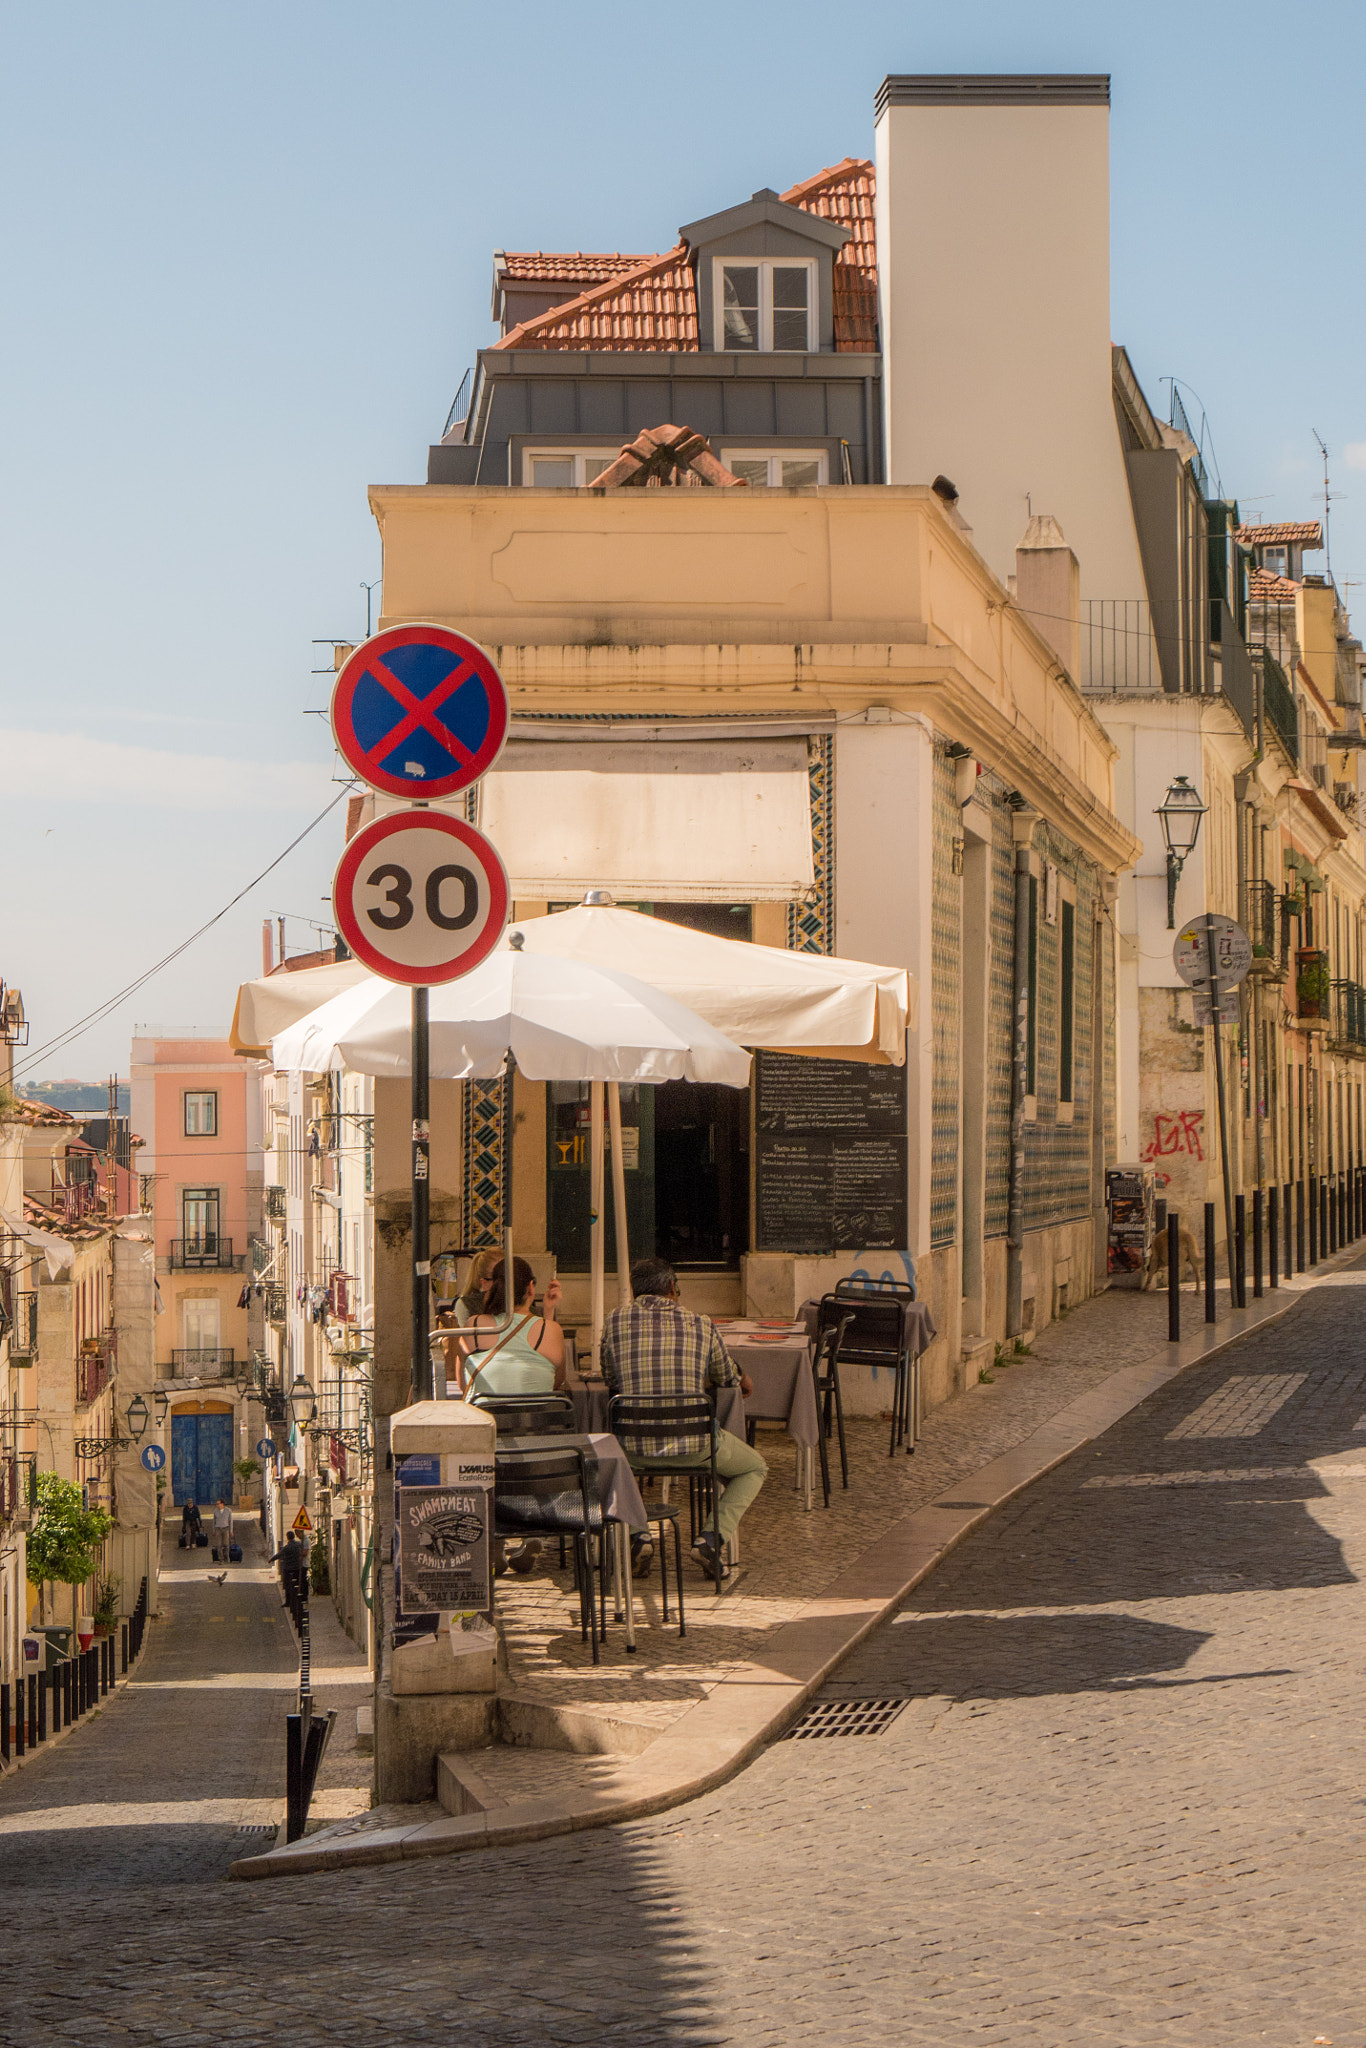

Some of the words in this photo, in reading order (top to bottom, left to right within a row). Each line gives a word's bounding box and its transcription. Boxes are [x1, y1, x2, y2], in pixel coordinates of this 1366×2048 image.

[366, 863, 478, 931] 30
[409, 1496, 477, 1527] SWAMPMEAT
[417, 1552, 447, 1569] FAMILY
[450, 1551, 472, 1568] BAND
[460, 1590, 486, 1601] APRIL
